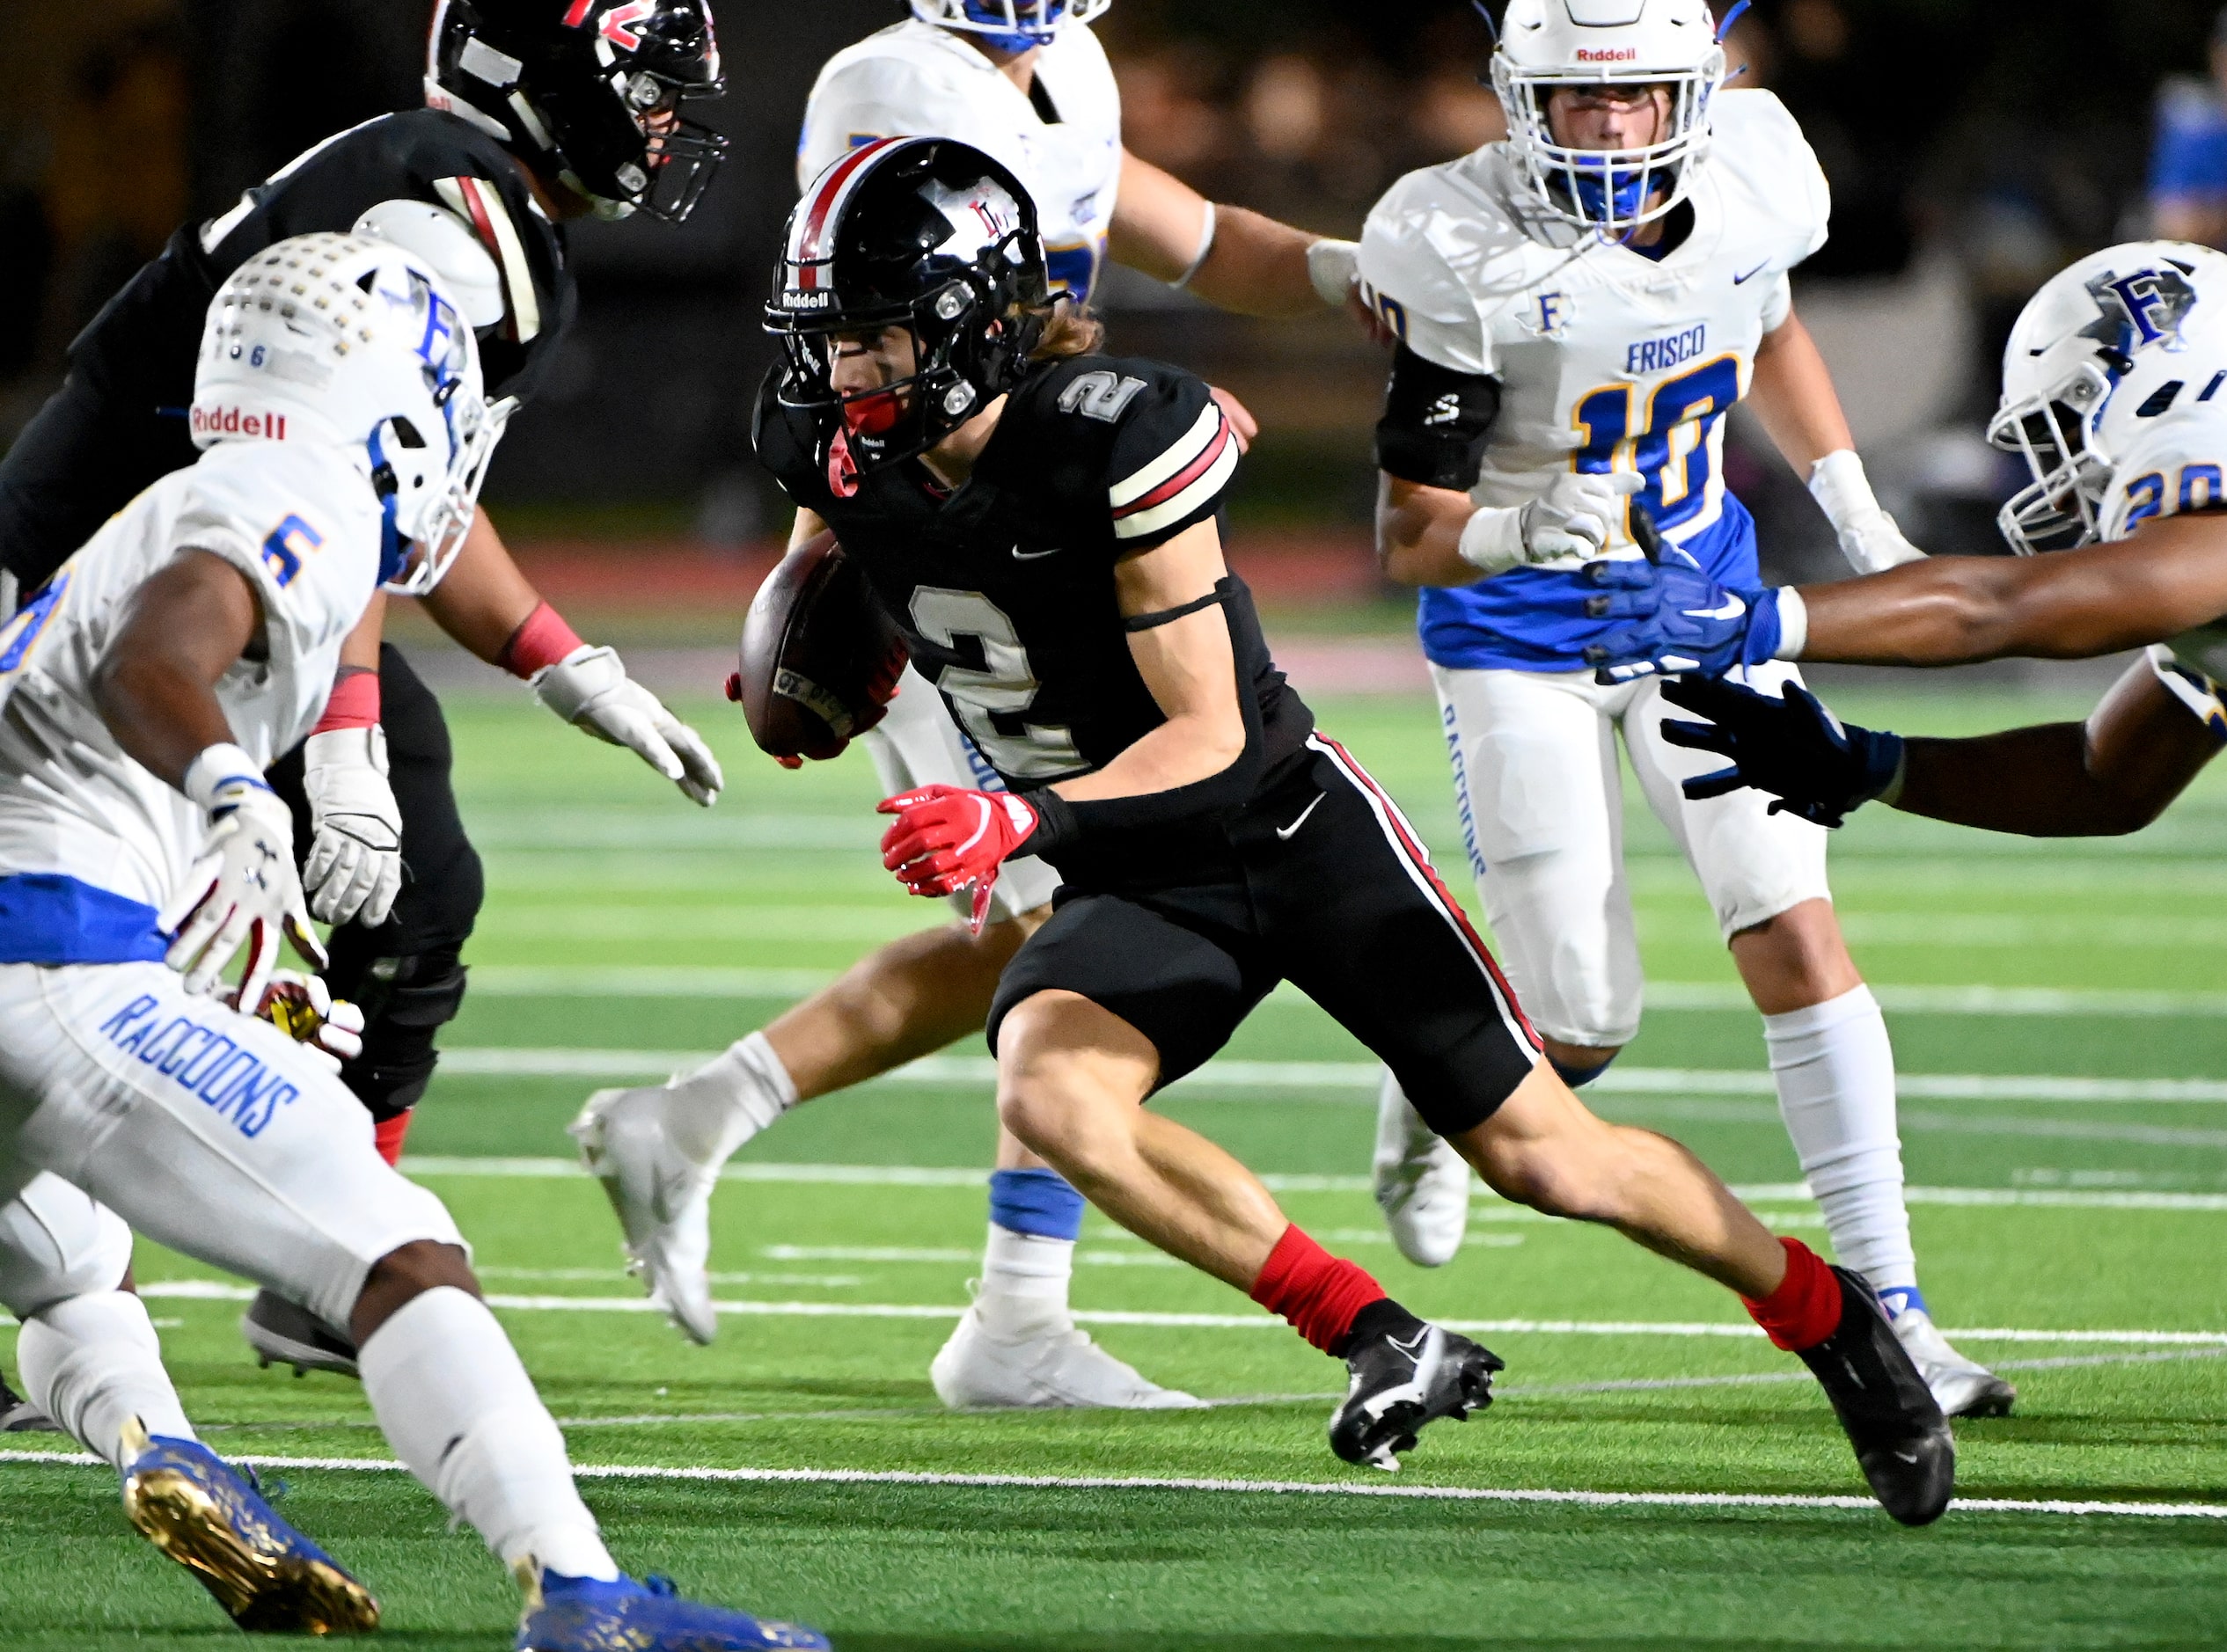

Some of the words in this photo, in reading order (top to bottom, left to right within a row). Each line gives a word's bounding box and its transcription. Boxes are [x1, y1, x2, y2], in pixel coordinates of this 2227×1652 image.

[1577, 48, 1636, 62] Riddell
[782, 292, 829, 308] Riddell
[1537, 291, 1562, 334] F
[2104, 267, 2168, 347] F
[1626, 324, 1705, 373] FRISCO
[1058, 370, 1147, 424] 2
[192, 406, 285, 440] Riddell
[1570, 352, 1742, 552] 10
[908, 585, 1092, 778] 2
[99, 993, 300, 1139] RACCOONS
